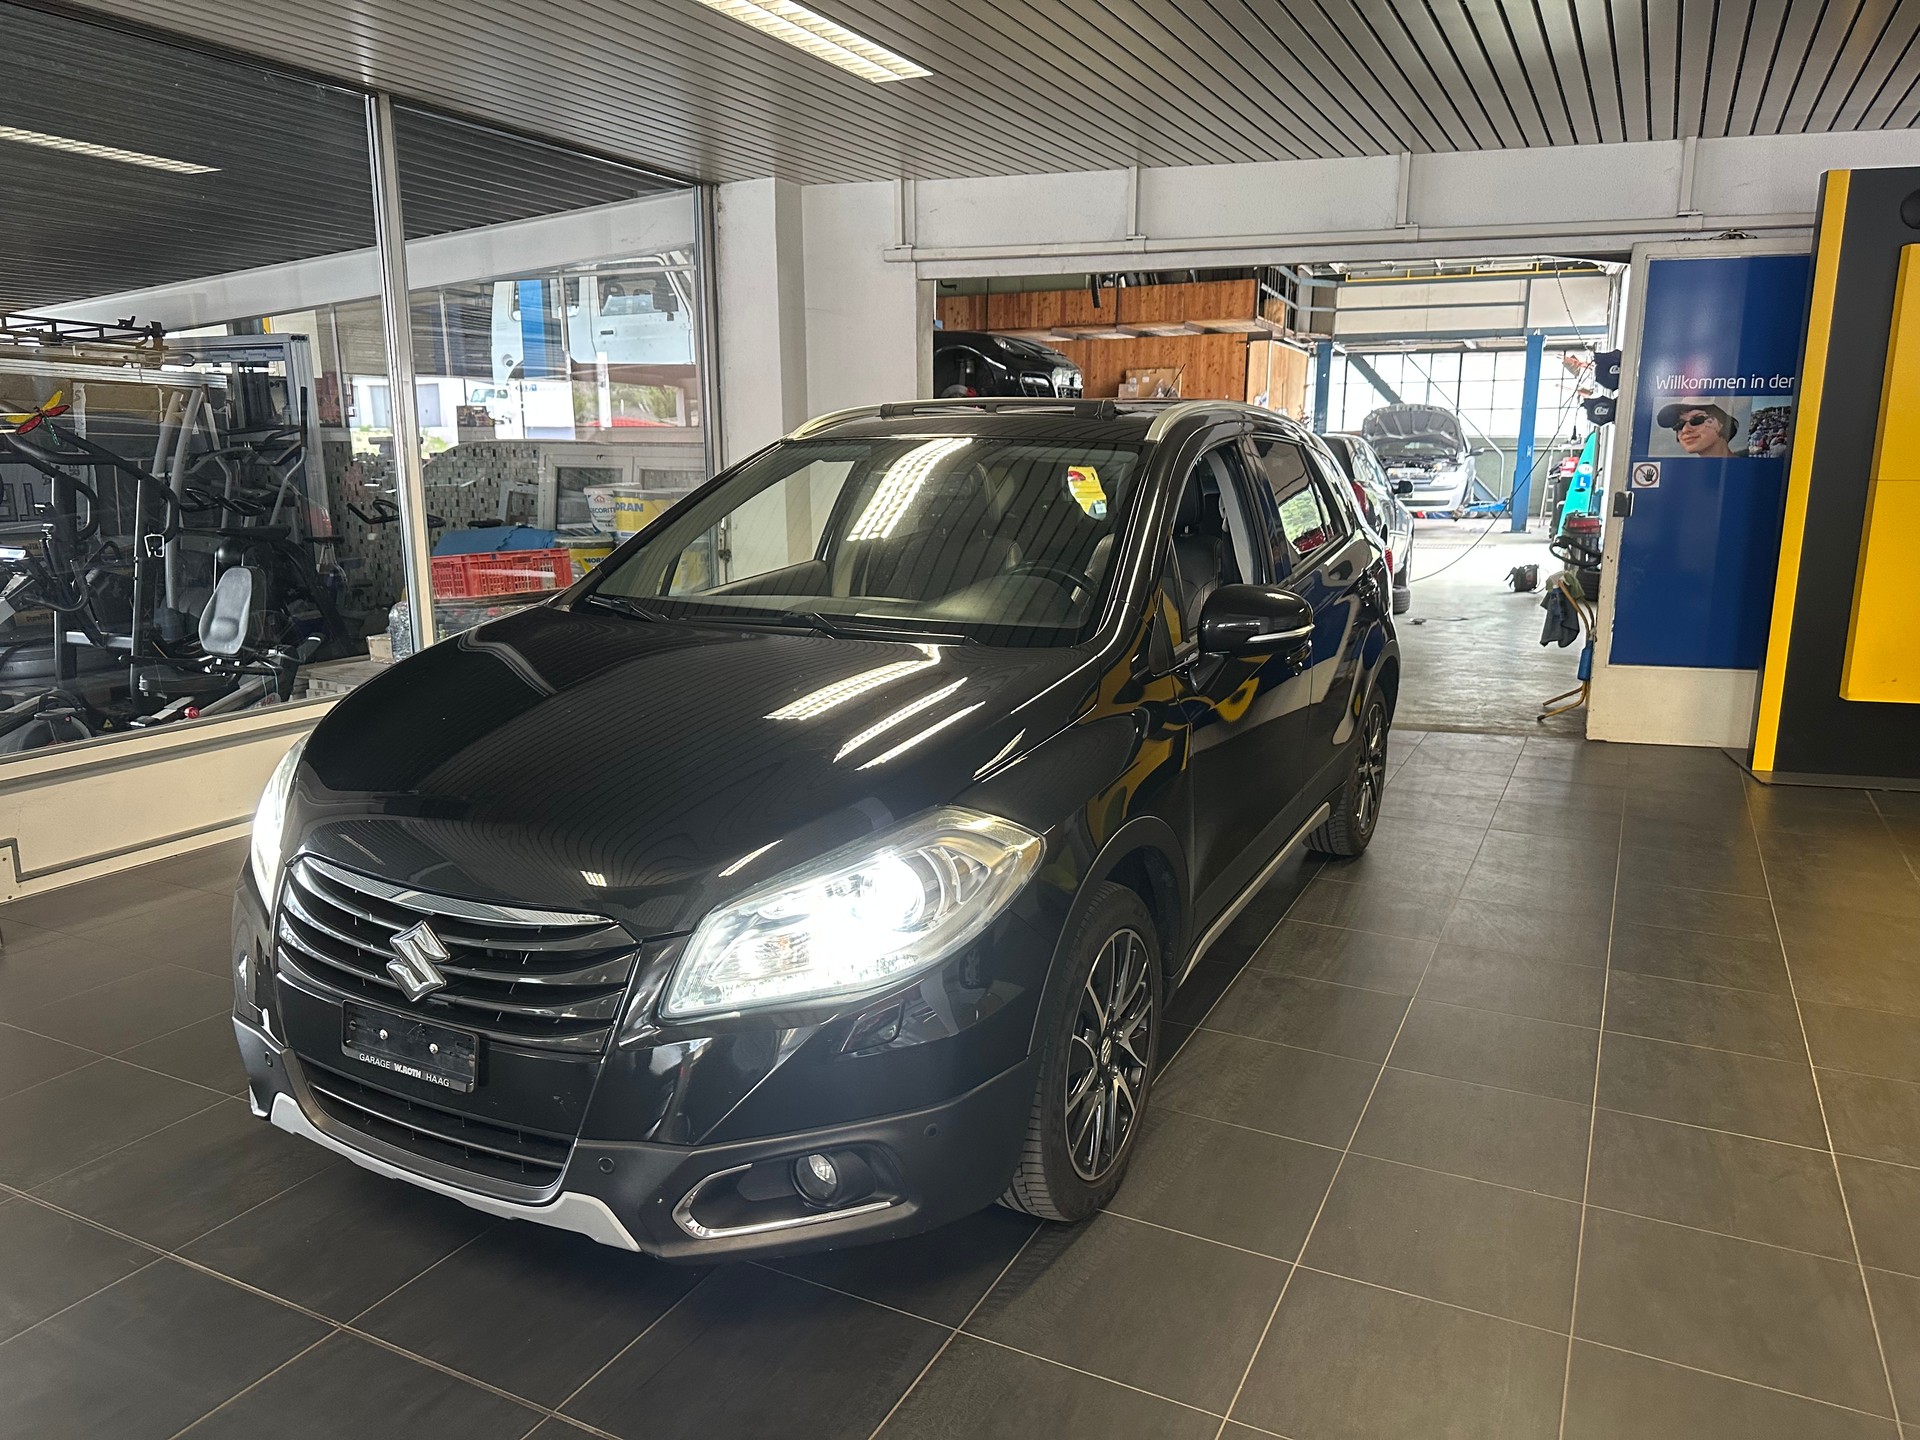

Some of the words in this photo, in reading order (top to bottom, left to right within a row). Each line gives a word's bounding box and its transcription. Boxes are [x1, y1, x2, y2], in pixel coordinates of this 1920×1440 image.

[1655, 374, 1746, 390] Willkommen
[1751, 374, 1767, 389] in
[1769, 373, 1795, 389] der
[615, 502, 644, 512] ORAN
[359, 1053, 390, 1069] GARAGE
[394, 1063, 422, 1079] W.ROTH
[425, 1073, 450, 1087] HAAG
